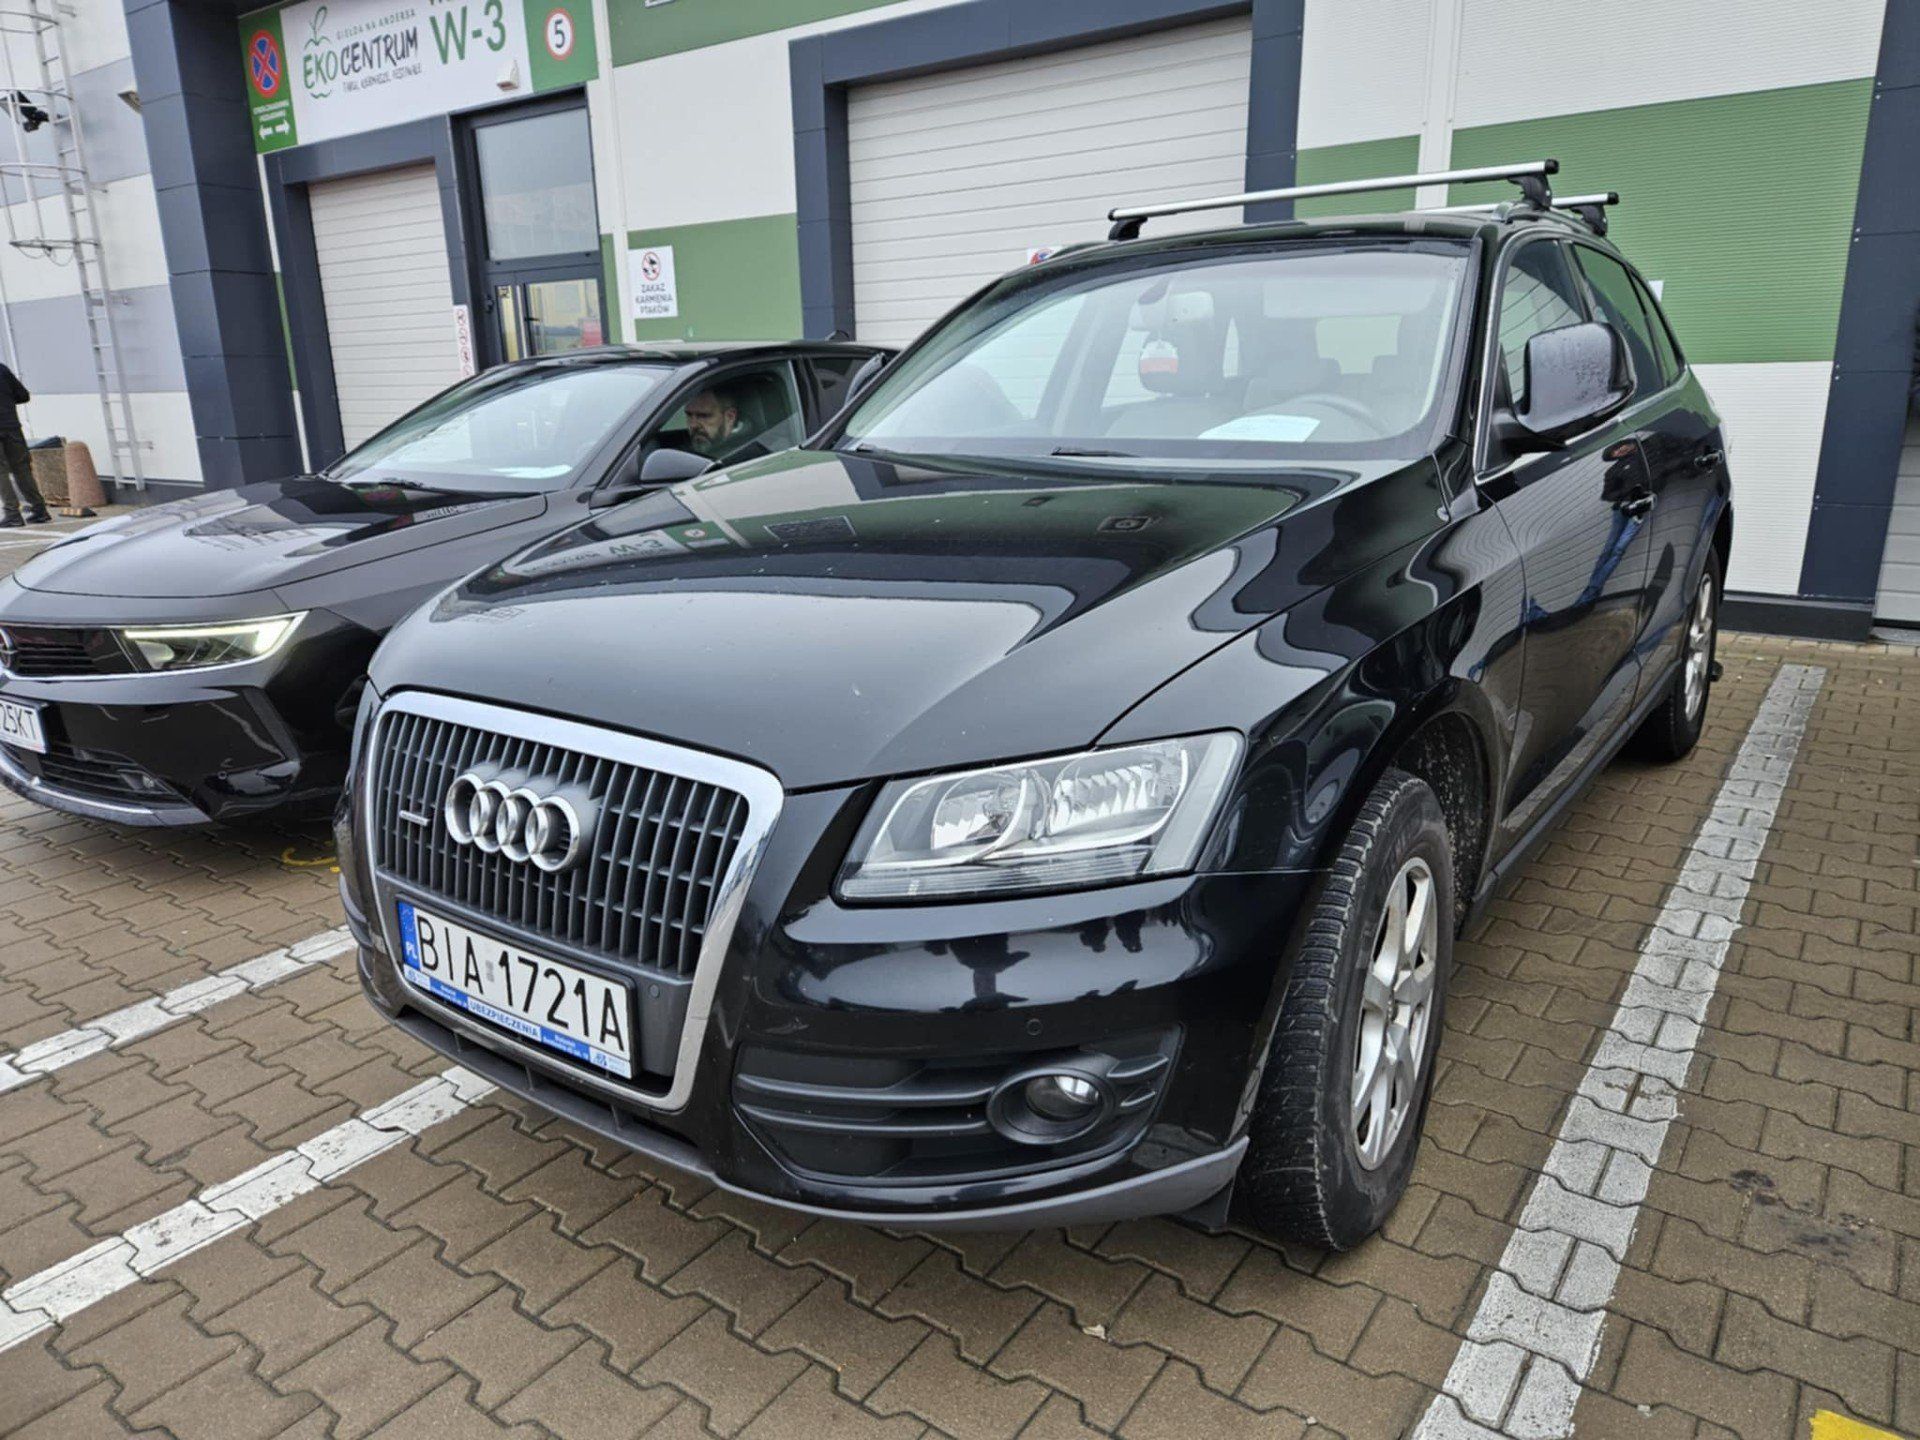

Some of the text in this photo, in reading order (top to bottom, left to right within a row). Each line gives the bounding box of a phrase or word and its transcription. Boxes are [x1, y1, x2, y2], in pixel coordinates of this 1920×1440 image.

[429, 0, 506, 65] W-3
[553, 19, 566, 49] 5
[641, 283, 666, 293] ZAKAZ
[405, 940, 418, 959] PL
[417, 915, 625, 1052] BIA 1721A
